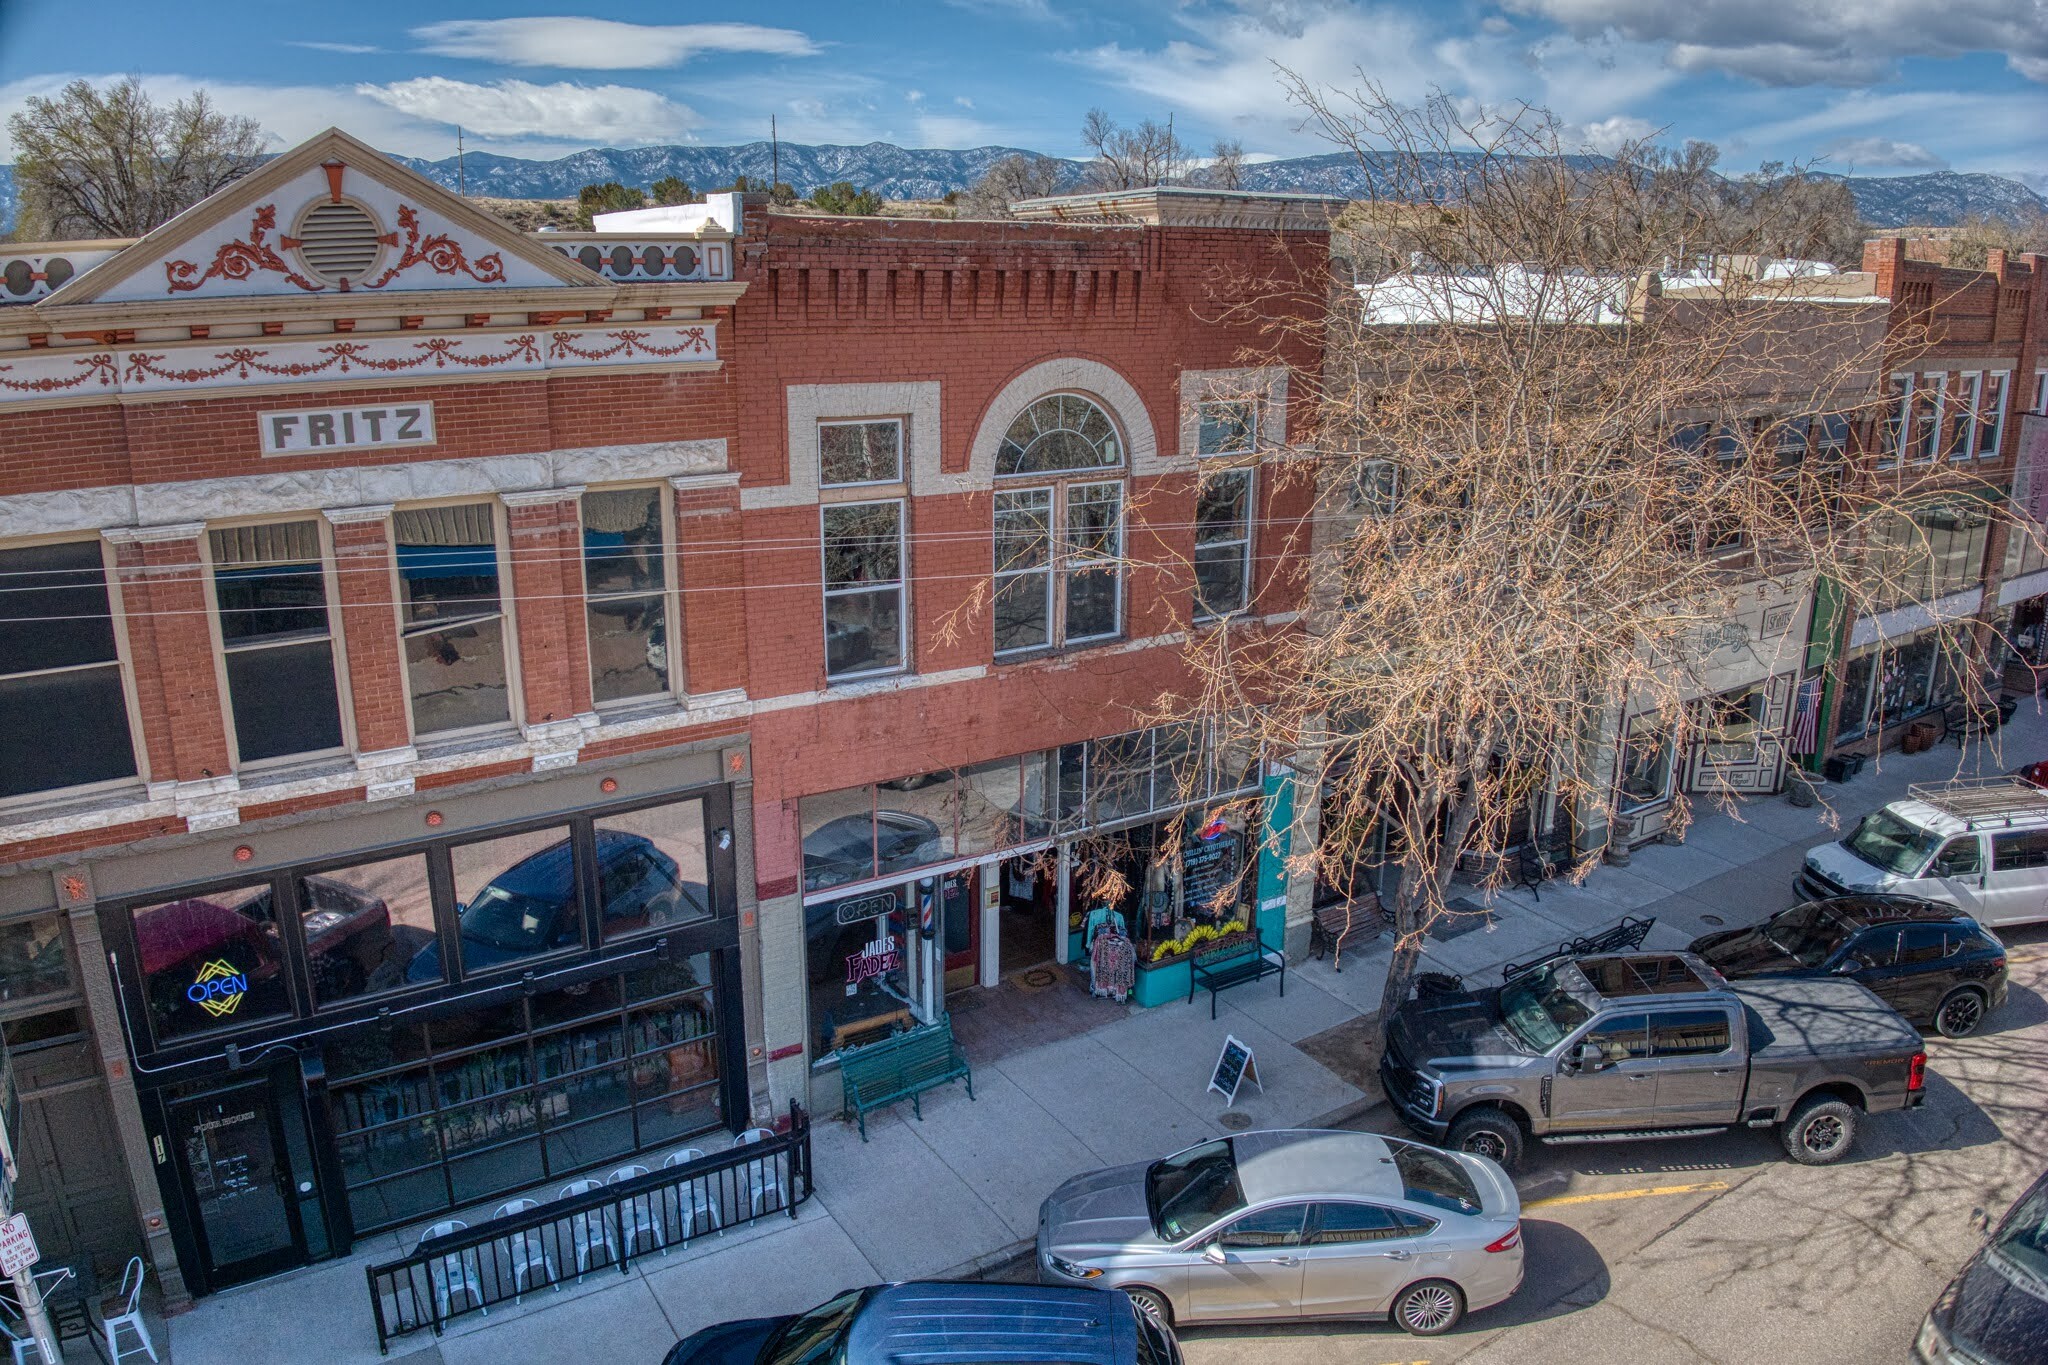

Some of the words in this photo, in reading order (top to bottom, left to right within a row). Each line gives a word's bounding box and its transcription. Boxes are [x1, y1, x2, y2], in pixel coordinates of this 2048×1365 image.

[272, 408, 423, 448] FRITZ
[842, 896, 892, 920] OPEN
[861, 936, 895, 958] JADES
[846, 951, 900, 983] FADEZ
[187, 974, 248, 1002] OPEN
[193, 1121, 221, 1133] POUR
[222, 1111, 255, 1126] HOUSE
[155, 1136, 165, 1163] 117
[2, 1223, 15, 1236] NO
